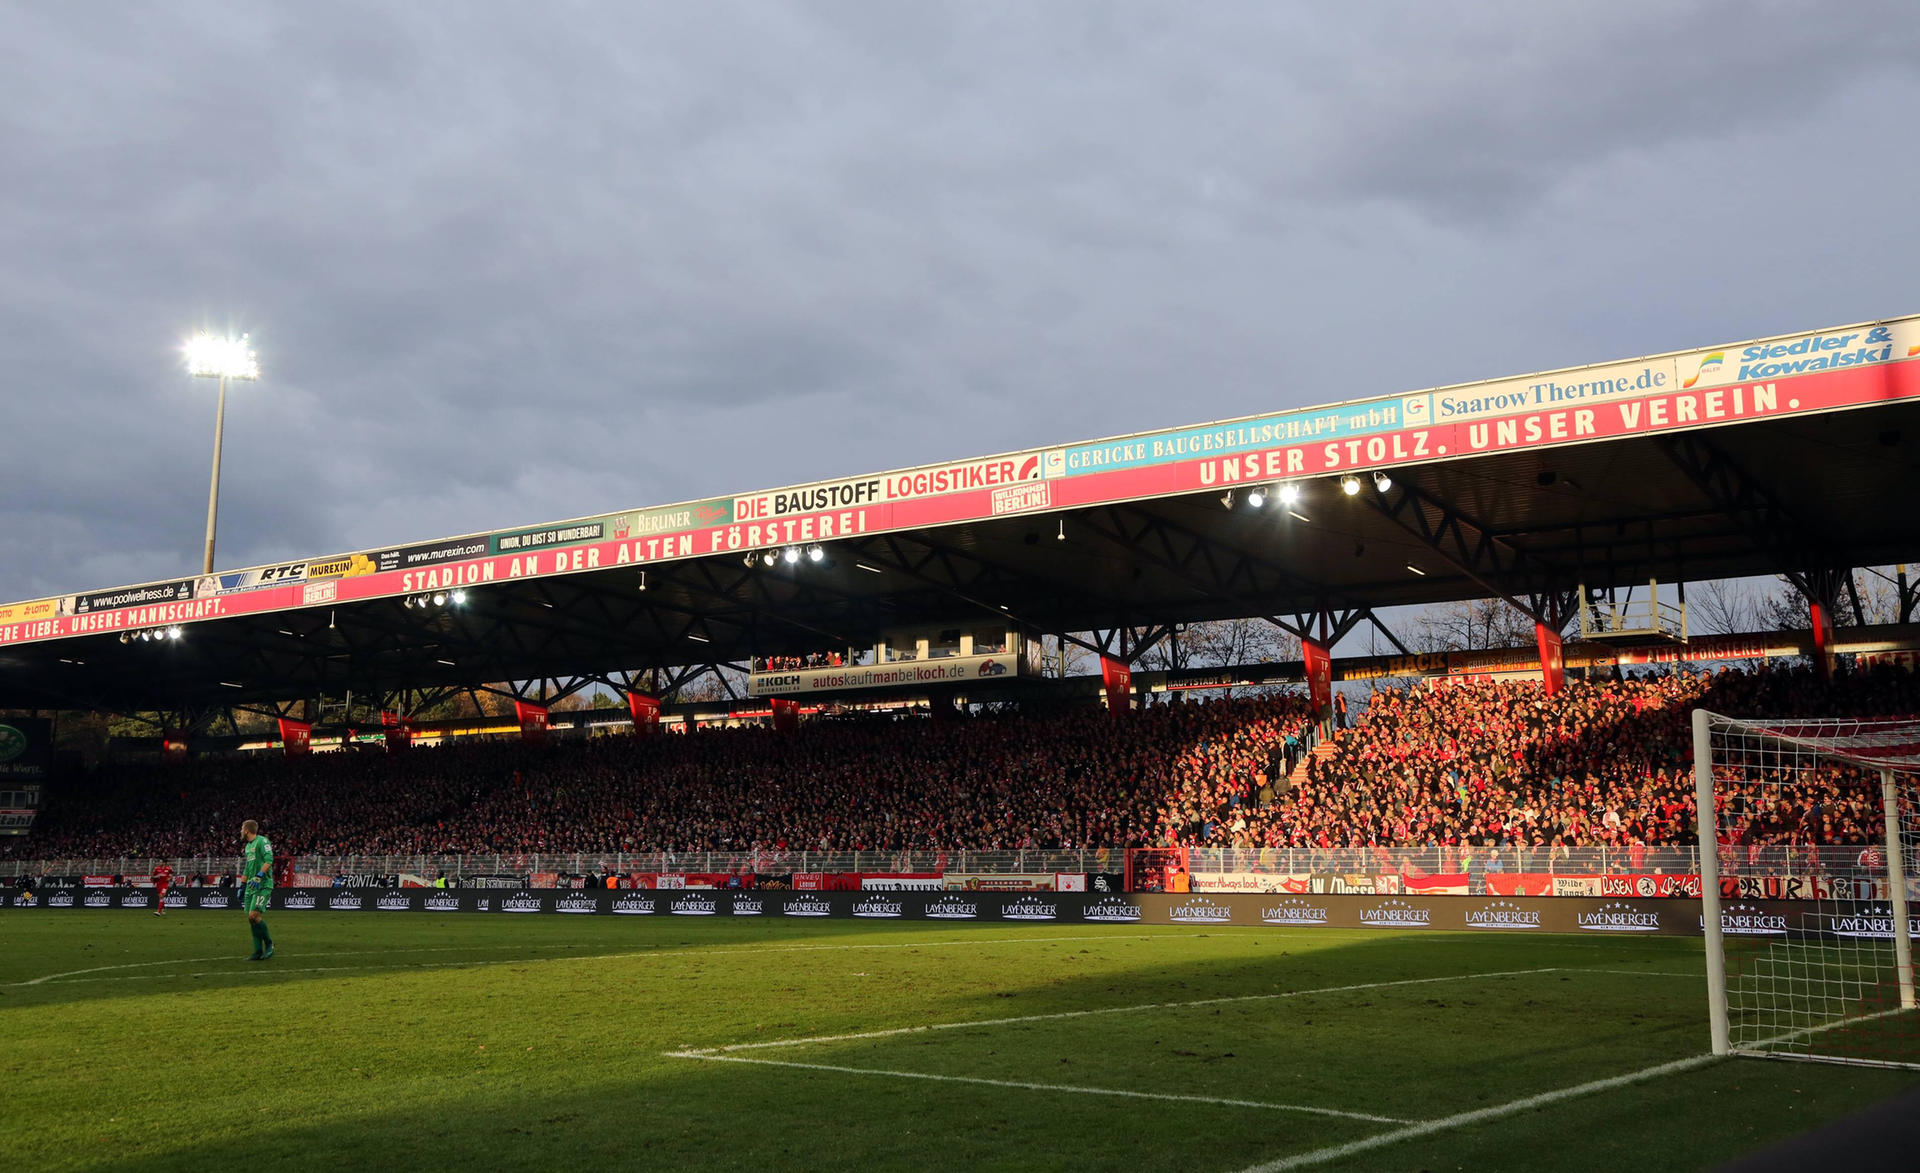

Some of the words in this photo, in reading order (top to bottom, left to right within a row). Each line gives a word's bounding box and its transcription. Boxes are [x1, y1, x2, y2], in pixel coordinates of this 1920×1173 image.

[1740, 333, 1859, 362] Siedler
[1864, 326, 1893, 344] &
[1738, 343, 1893, 380] Kowalski
[1441, 369, 1666, 417] SaarowTherme.de
[1069, 443, 1146, 469] GERICKE
[1153, 415, 1339, 457] BAUGESELLSCHAFT
[1350, 406, 1397, 430] mbH
[1200, 448, 1304, 485] UNSER
[1325, 431, 1447, 468] STOLZ.
[1469, 409, 1595, 449] UNSER
[1619, 383, 1800, 429] VEREIN.
[737, 497, 768, 520] DIE
[775, 480, 880, 514] BAUSTOFF
[887, 460, 1015, 498] LOGISTIKER
[995, 492, 1047, 515] BERLIN!
[638, 511, 691, 533] BERLINER
[522, 535, 531, 547] DU
[532, 532, 546, 545] BIST
[547, 532, 557, 543] SO
[557, 524, 601, 542] WUNDERBAR!
[403, 560, 495, 592] STADION
[510, 556, 538, 578] AN
[556, 548, 600, 572] DER
[617, 534, 693, 565] ALTEN
[712, 510, 865, 552] FÖRSTEREI
[407, 543, 485, 563] www.murexin.com
[260, 563, 306, 581] RTC
[310, 562, 350, 577] MUREXIN
[93, 586, 174, 608] www.poolwellness.de
[31, 604, 50, 615] LOTTO
[25, 620, 64, 639] LIEBE.
[72, 612, 121, 632] UNSERE
[128, 598, 226, 626] MANNSCHAFT.
[766, 676, 800, 687] KOCH
[812, 664, 965, 689] autoskauftmanbeikoch.de
[1243, 876, 1259, 888] look
[1557, 879, 1583, 888] Wilde
[1603, 876, 1633, 895] RASEN
[255, 896, 265, 906] 12
[502, 898, 542, 908] LAYENBERGER
[612, 900, 655, 910] LAYENBERGER
[671, 901, 717, 911] LAYENBERGER
[783, 902, 831, 912] LAYENBERGER
[852, 902, 902, 913] LAYENBERGER
[925, 903, 977, 914] LAYENBERGER
[1002, 904, 1057, 915] LAYENBERGER
[1083, 905, 1142, 916] LAYENBERGER
[1169, 906, 1231, 918] LAYENBERGER
[1262, 907, 1328, 920] LAYENBERGER
[1360, 909, 1430, 921] LAYENBERGER
[1465, 911, 1540, 924] LAYENBERGER
[1578, 912, 1659, 926] LAYENBERGER
[1700, 915, 1786, 929] LENBERGER
